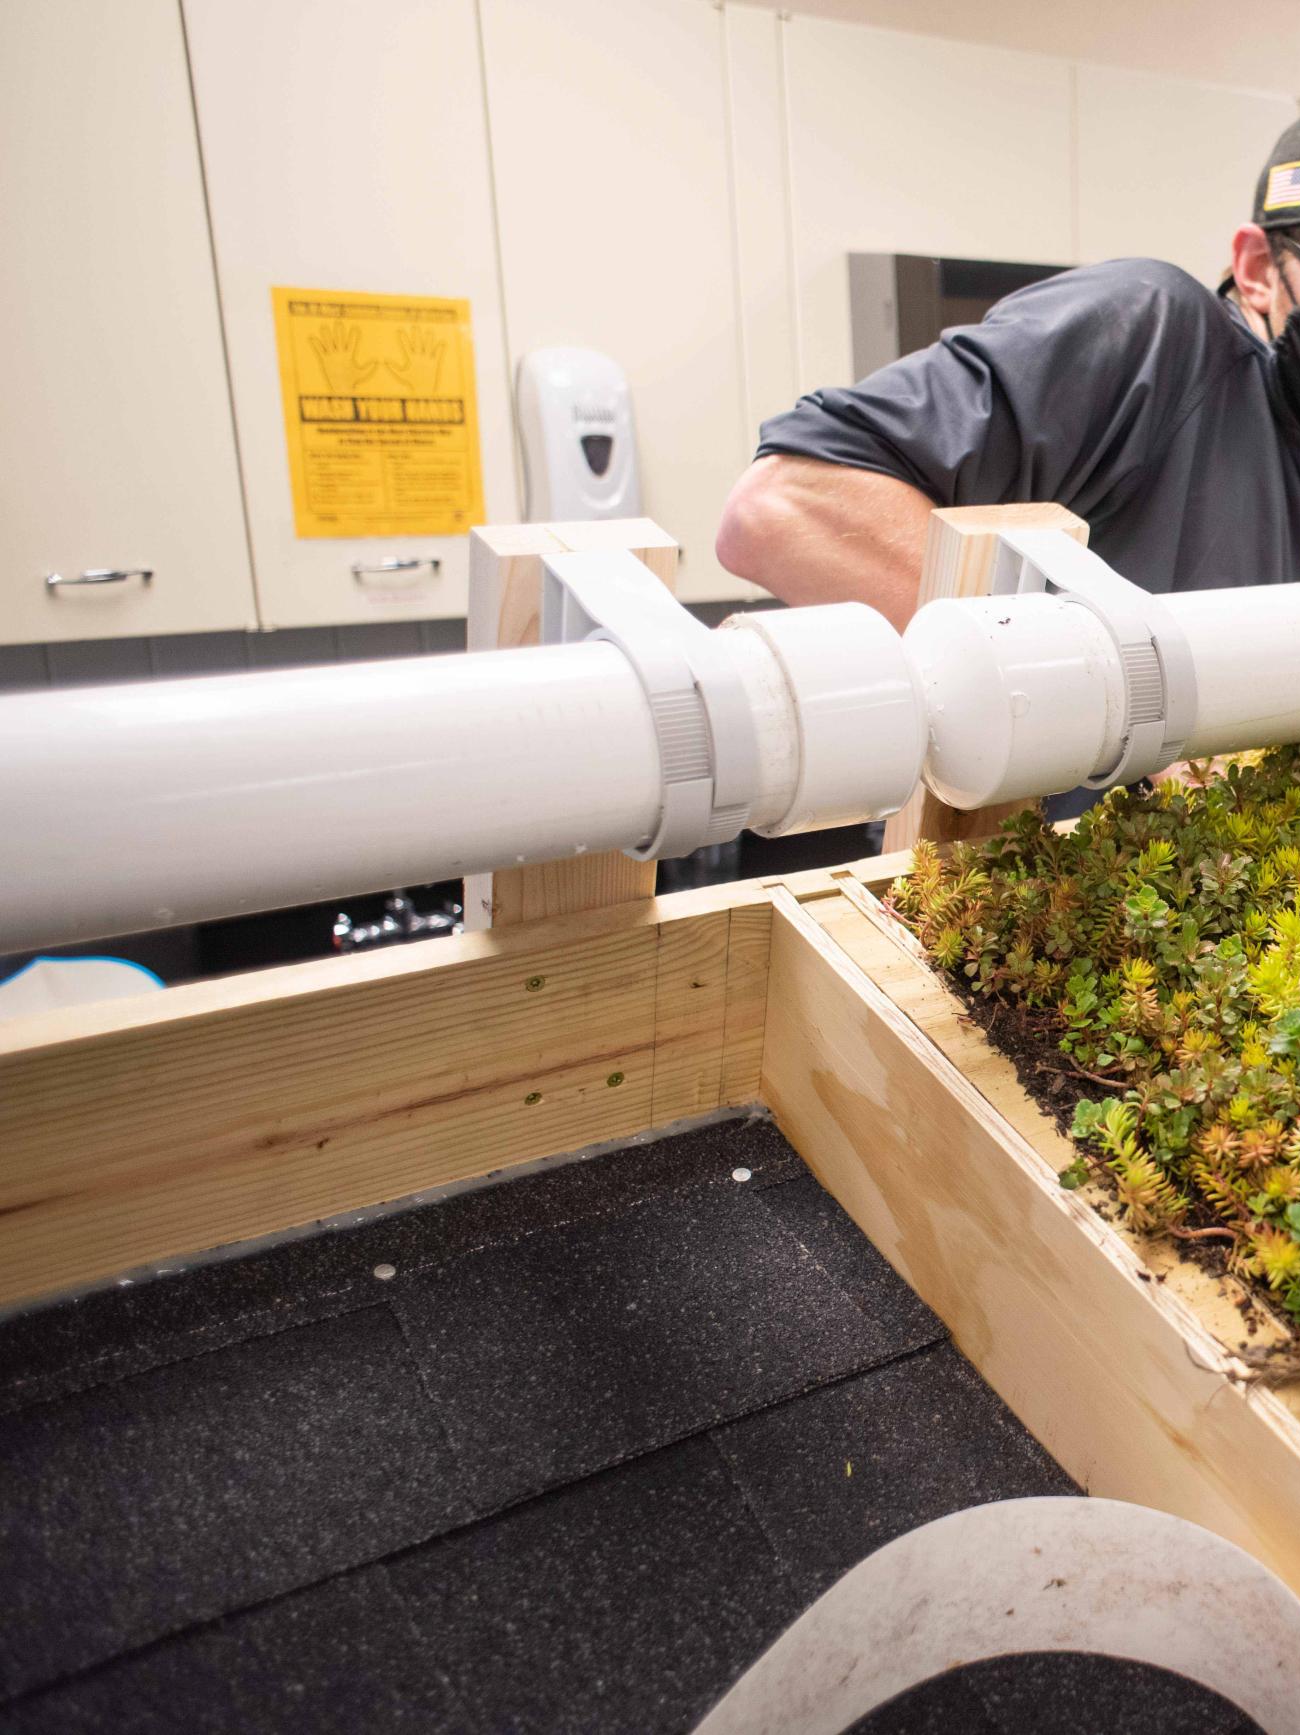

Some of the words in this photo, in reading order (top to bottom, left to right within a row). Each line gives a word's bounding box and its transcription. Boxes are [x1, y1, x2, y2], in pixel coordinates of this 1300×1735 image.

[301, 398, 355, 420] WASH
[357, 399, 404, 421] YOUR
[406, 400, 463, 422] HANDS
